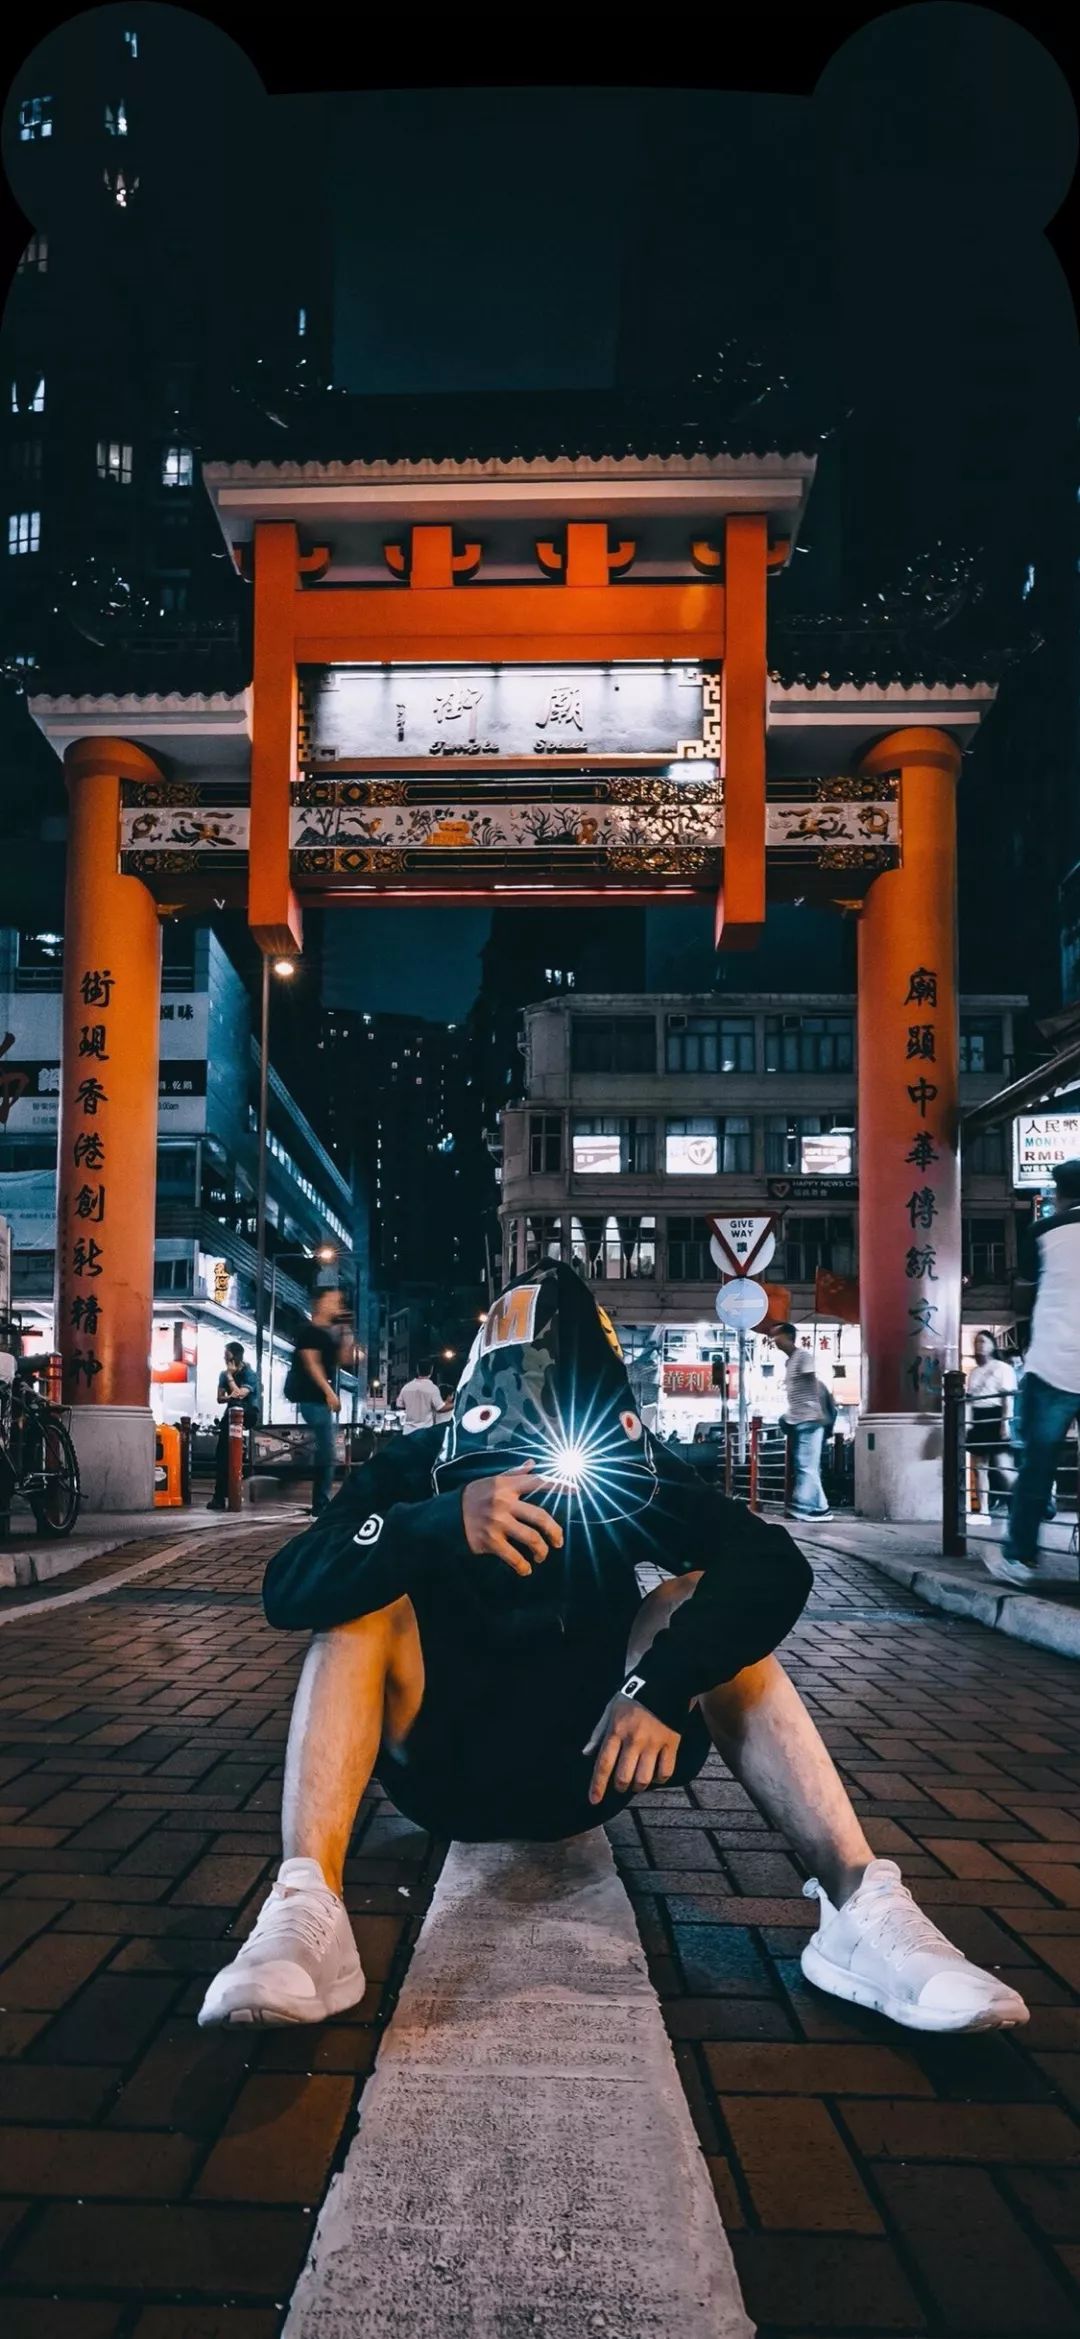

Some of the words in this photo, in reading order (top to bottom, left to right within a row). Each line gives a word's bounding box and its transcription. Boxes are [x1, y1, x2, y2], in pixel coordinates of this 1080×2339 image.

[1024, 1151, 1065, 1161] RMB
[730, 1220, 754, 1228] GIVE
[731, 1230, 754, 1238] WAY
